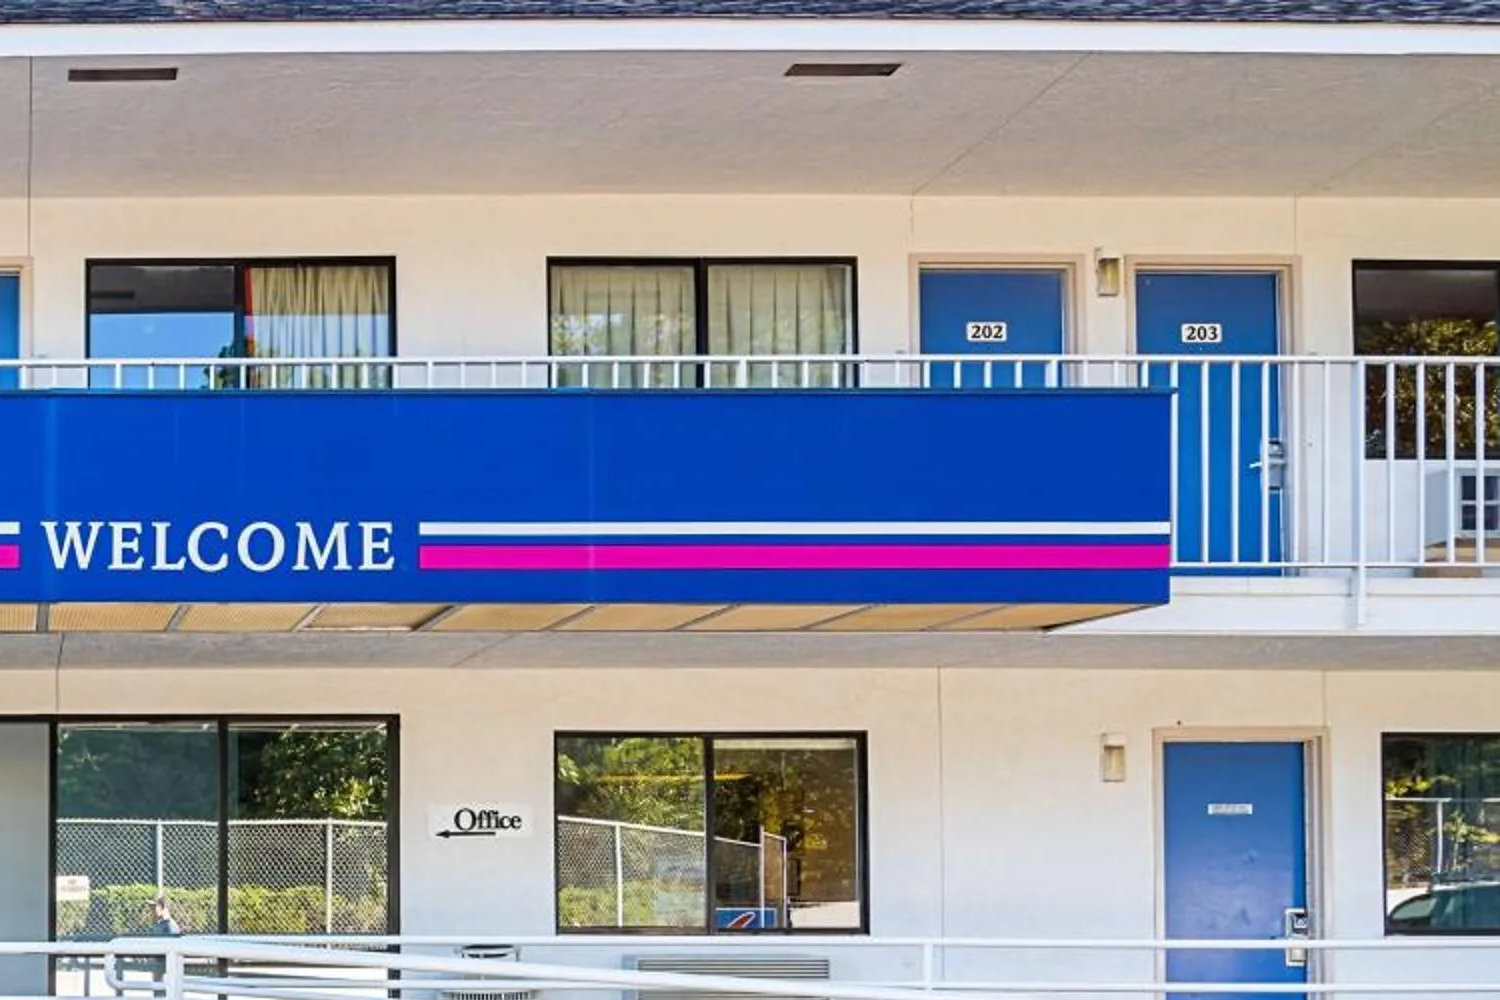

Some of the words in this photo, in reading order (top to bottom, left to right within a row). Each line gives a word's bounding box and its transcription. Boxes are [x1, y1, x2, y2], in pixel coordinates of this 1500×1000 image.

[971, 325, 1003, 339] 202
[1186, 326, 1218, 341] 203
[40, 521, 395, 573] WELCOME
[453, 807, 522, 832] Office
